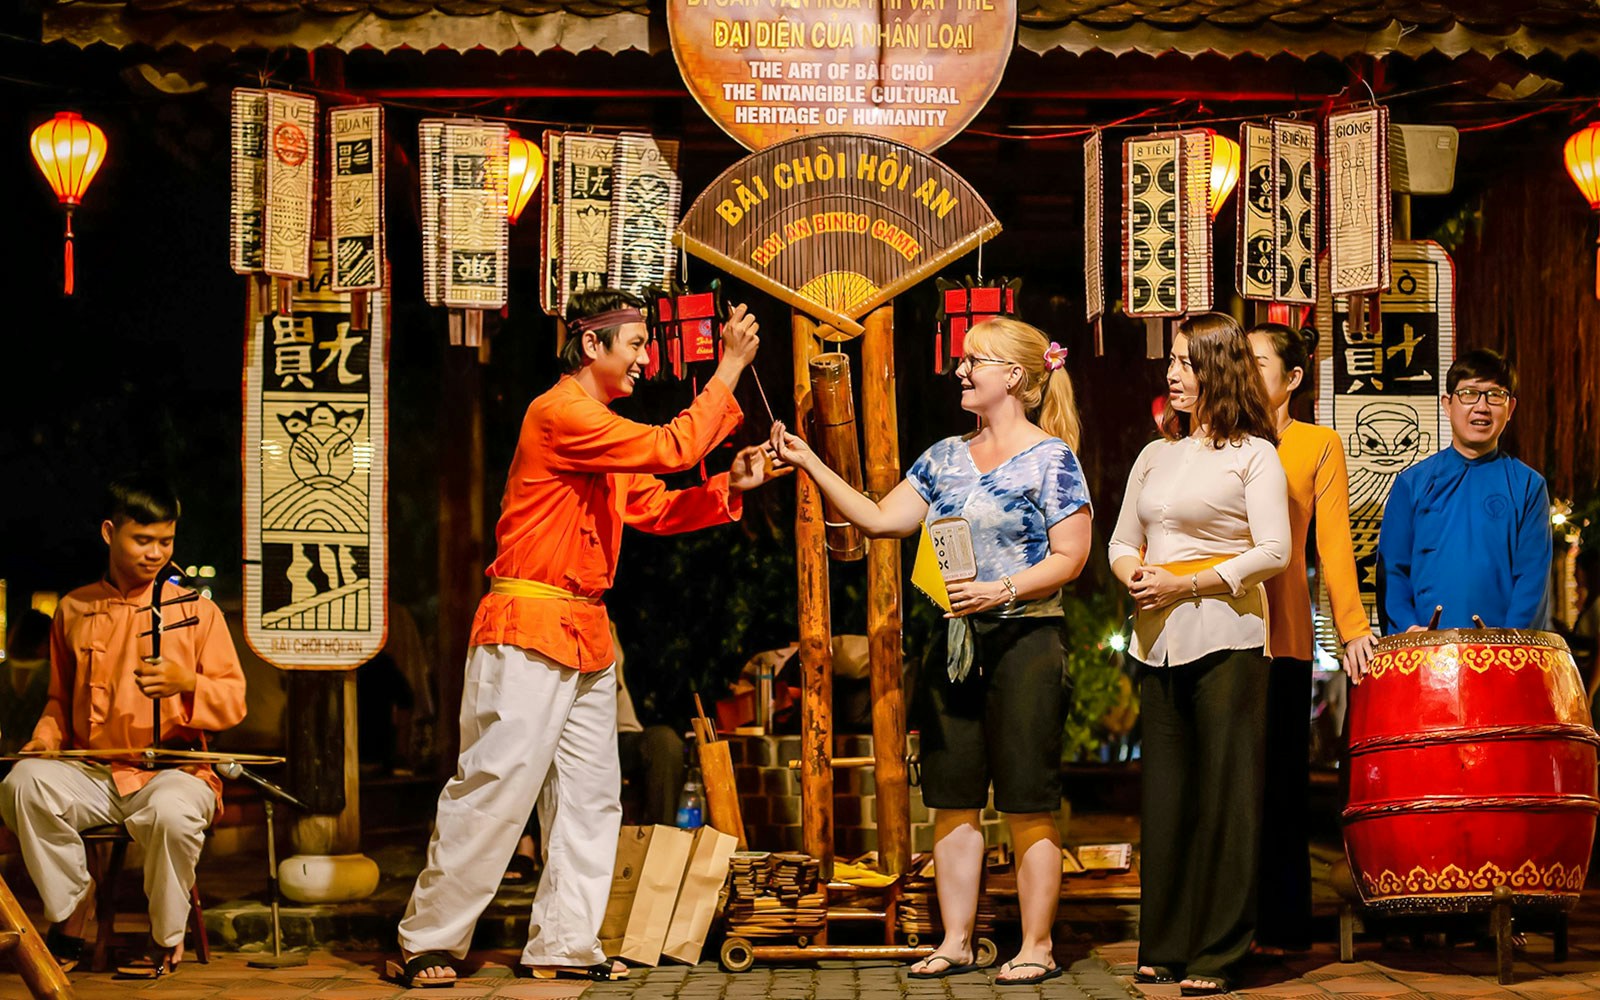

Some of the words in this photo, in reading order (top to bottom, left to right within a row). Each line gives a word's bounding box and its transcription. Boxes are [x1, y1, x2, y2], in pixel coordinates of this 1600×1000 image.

[714, 21, 749, 53] ĐẠI
[756, 15, 804, 53] DIỆN
[811, 12, 854, 48] CỦA
[861, 17, 919, 49] NHÂN
[927, 23, 973, 54] LOẠI
[749, 61, 782, 79] THE
[788, 62, 822, 79] ART
[827, 63, 850, 80] OF
[855, 63, 886, 80] BÀI
[891, 60, 934, 81] CHÒI
[722, 84, 756, 100] THE
[761, 84, 866, 103] INTANGIBLE
[871, 86, 960, 104] CULTURAL
[735, 106, 820, 124] HERITAGE
[825, 108, 848, 125] OF
[853, 108, 947, 126] HUMANITY
[1137, 147, 1143, 157] 8
[715, 179, 769, 227] BÀI
[773, 146, 846, 190] CHÒI
[857, 152, 913, 192] HỘI
[912, 177, 959, 219] AN
[784, 217, 813, 245] AN
[812, 211, 870, 235] BINGO
[871, 218, 923, 262] GAME
